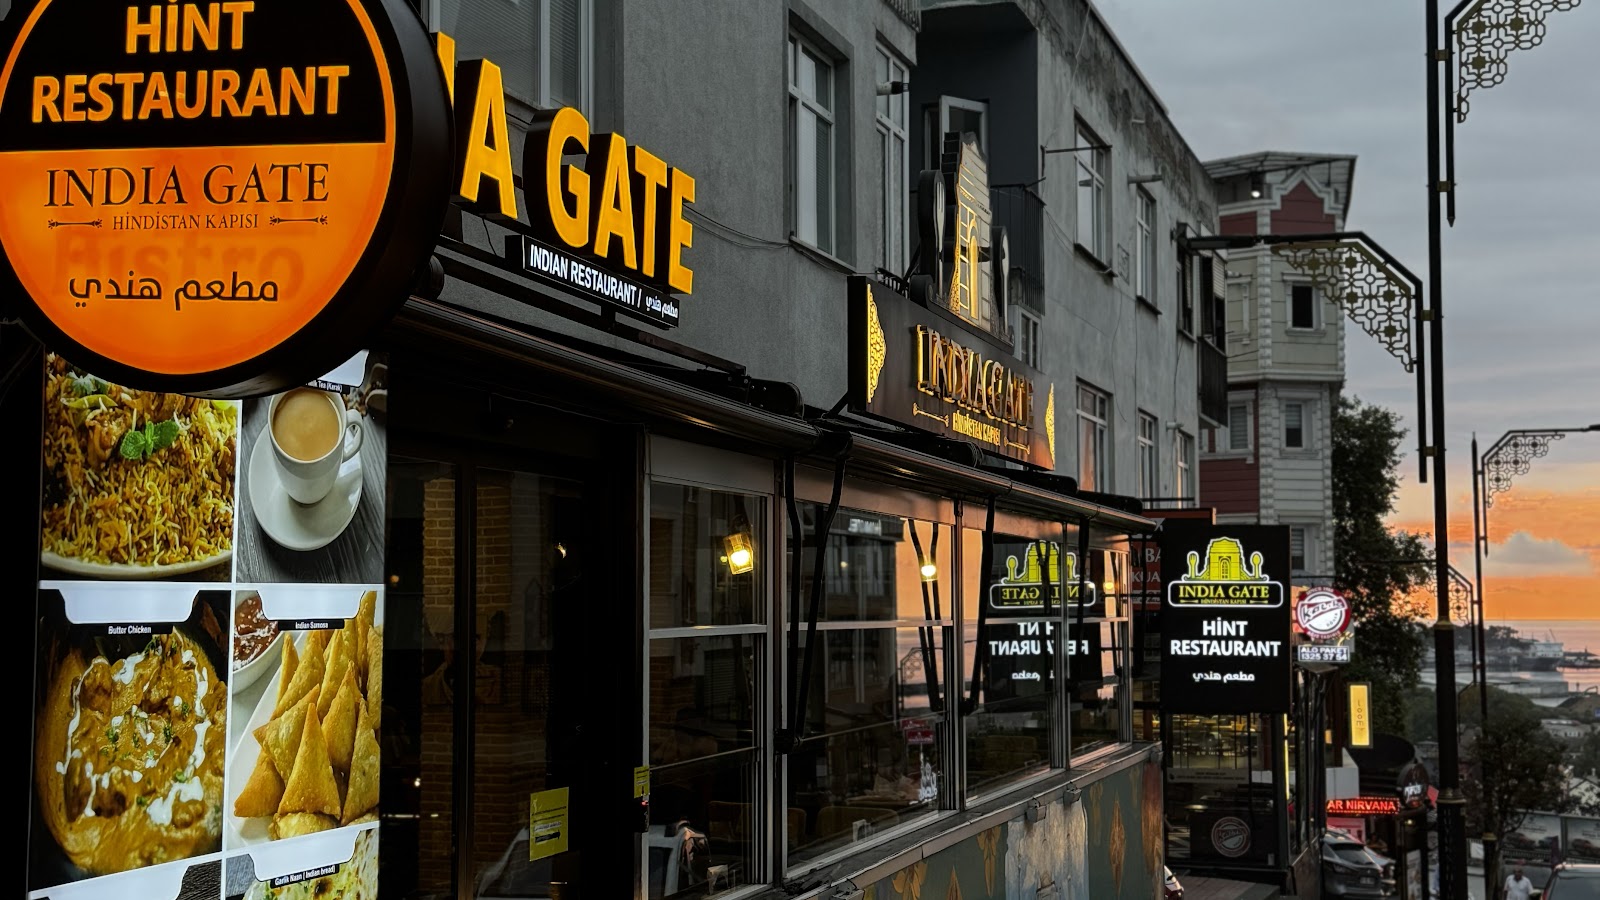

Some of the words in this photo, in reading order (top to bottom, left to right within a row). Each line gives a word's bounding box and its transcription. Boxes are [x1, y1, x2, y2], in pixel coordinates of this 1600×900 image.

[126, 0, 254, 54] HİNT
[31, 65, 350, 123] RESTAURANT
[44, 164, 189, 208] INDIA
[202, 162, 330, 206] GATE
[546, 107, 696, 295] GATE
[112, 211, 200, 231] HİNDİSTAN
[205, 213, 259, 230] KAPISI
[530, 243, 568, 280] INDIAN
[570, 260, 637, 306] RESTAURANT
[69, 270, 162, 308] هندي
[174, 271, 279, 310] مطعم
[1178, 585, 1226, 598] INDIA
[1228, 585, 1270, 598] GATE
[107, 625, 127, 635] Butter
[127, 625, 152, 634] Chicken
[1202, 616, 1249, 637] HİNT
[1170, 639, 1282, 657] RESTAURANT
[1193, 670, 1222, 682] هندي
[1223, 671, 1255, 683] مطعم
[1346, 800, 1397, 811] NIRVANA
